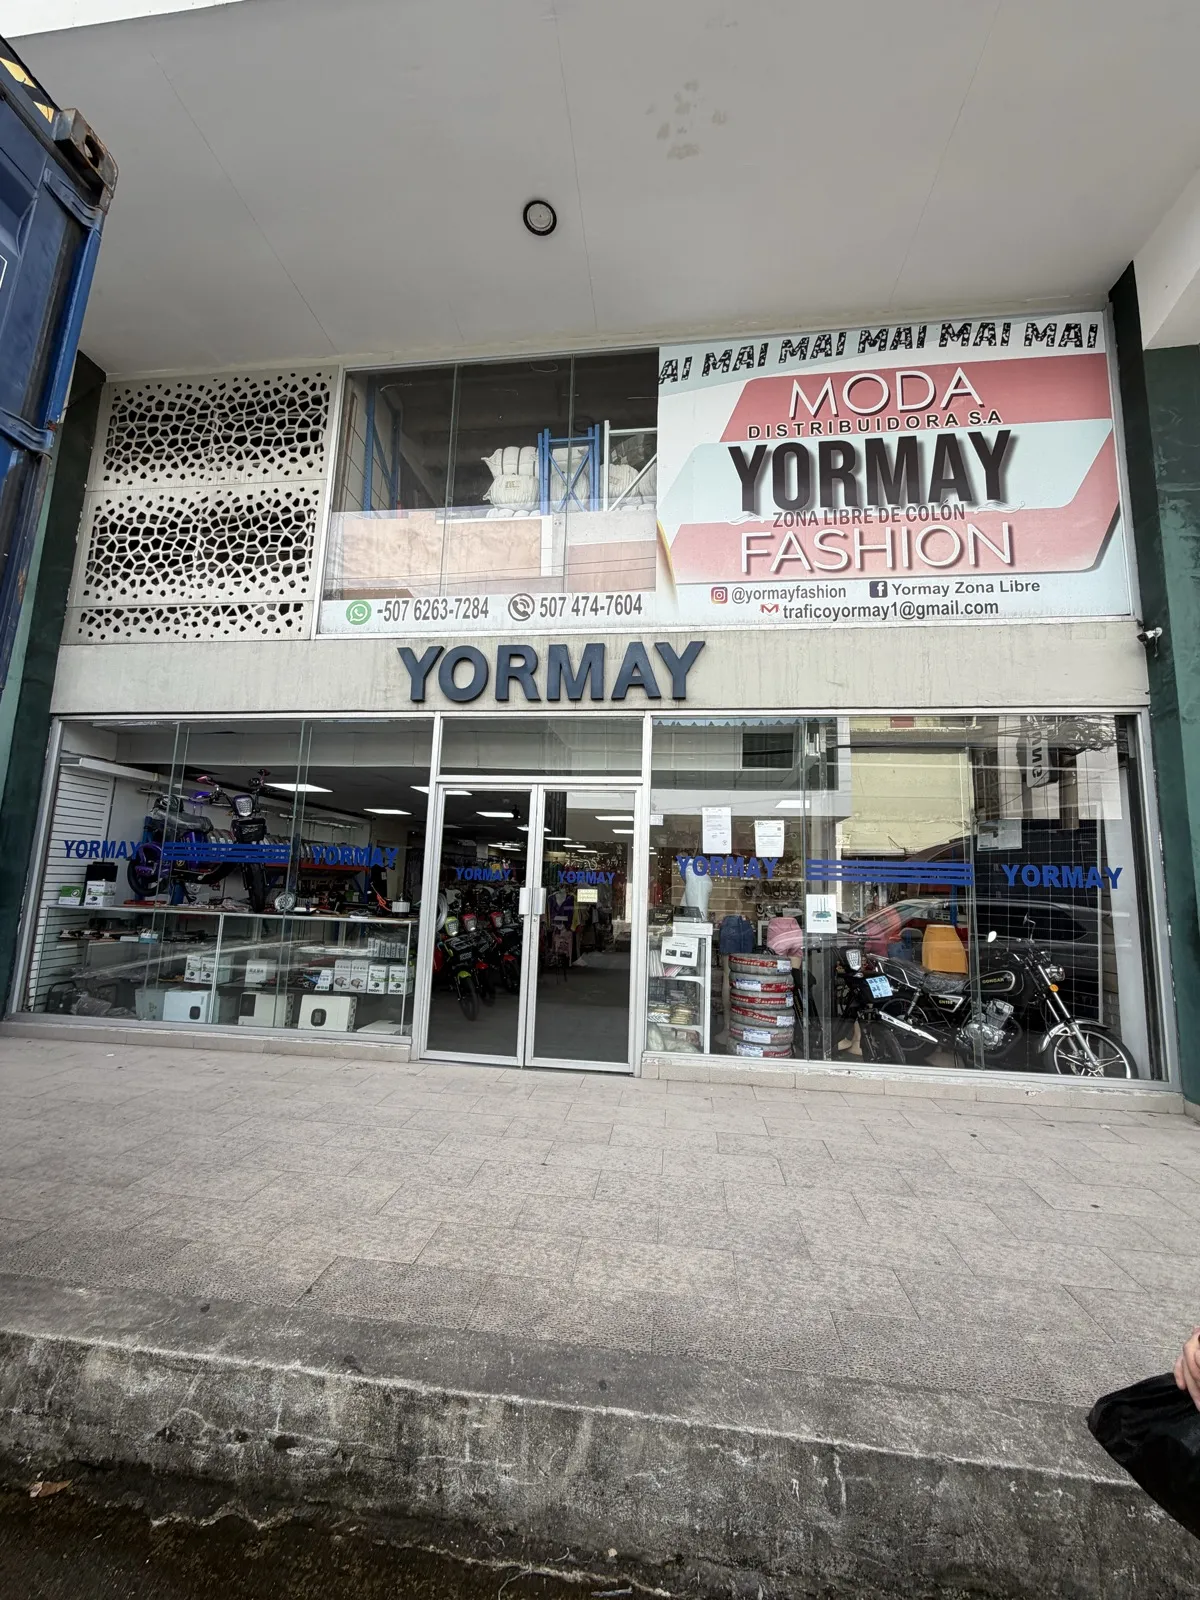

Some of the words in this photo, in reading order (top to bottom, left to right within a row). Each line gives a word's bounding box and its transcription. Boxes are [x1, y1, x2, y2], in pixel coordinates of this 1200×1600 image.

[702, 342, 769, 377] MAI
[778, 331, 847, 364] MAI
[857, 325, 927, 353] MAI
[938, 322, 1012, 348] MAI
[1024, 322, 1099, 348] MAI
[788, 366, 985, 419] MODA
[748, 413, 960, 439] DISTRIBUIDORA
[969, 410, 1002, 426] S.A
[727, 430, 1012, 512] YORMAY
[772, 509, 819, 528] ZONA
[823, 507, 874, 526] LIBRE
[878, 506, 901, 524] DE
[905, 499, 965, 523] COLÓN
[740, 521, 1013, 574] FASHION
[731, 585, 847, 604] @yormayfashion
[891, 583, 950, 598] Yormay
[954, 581, 995, 595] Zona
[999, 580, 1041, 593] Libre
[413, 596, 489, 621] 6263-7284
[539, 596, 567, 618] 507
[571, 593, 643, 617] 474-7604
[783, 600, 999, 622] traficoyormay1@gmail.com
[397, 641, 706, 703] YORMAY
[64, 840, 141, 859] YORMAY
[311, 845, 399, 868] YORMAY
[455, 867, 512, 882] YORMAY
[557, 870, 616, 885] YORMAY
[676, 855, 779, 880] YORMAY
[1001, 863, 1123, 889] YORMAY
